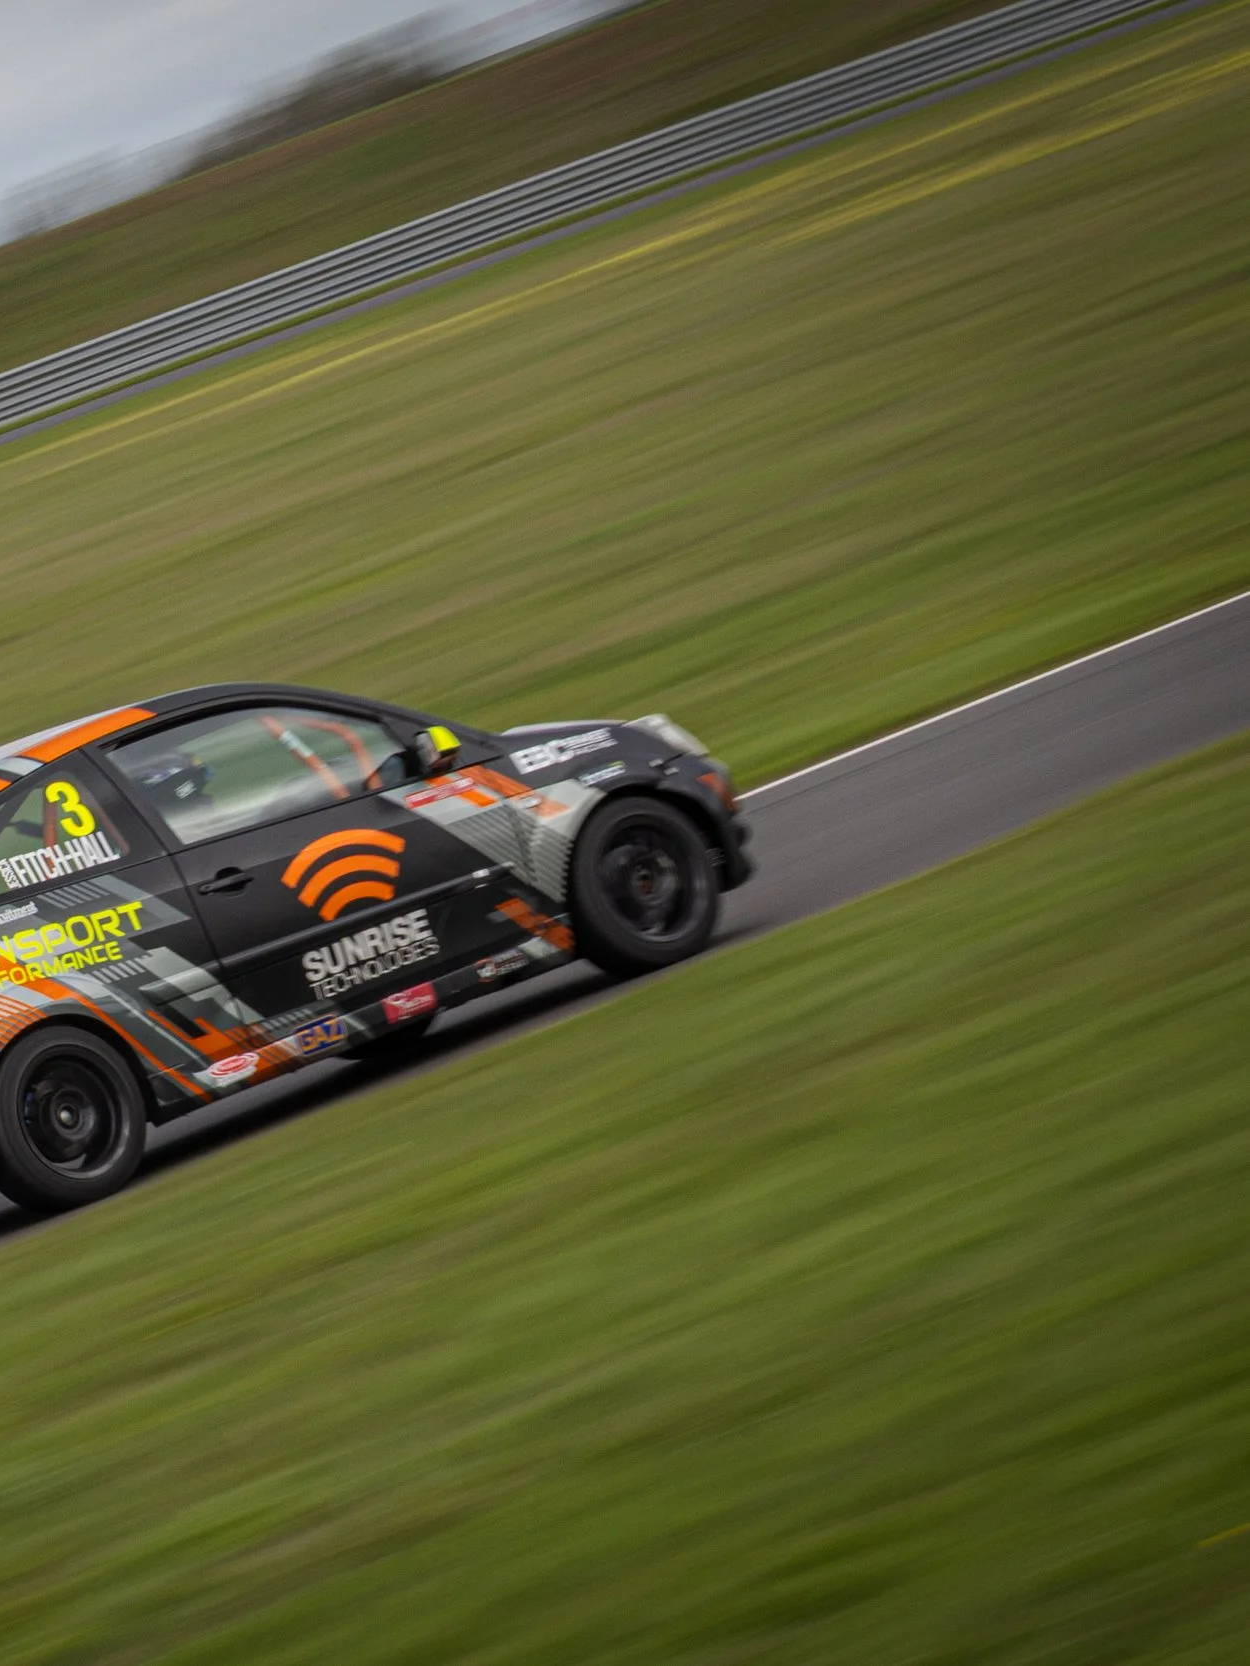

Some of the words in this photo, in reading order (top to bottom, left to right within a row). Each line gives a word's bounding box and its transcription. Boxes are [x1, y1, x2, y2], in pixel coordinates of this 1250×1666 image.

[45, 781, 96, 837] 3
[9, 831, 121, 887] FITCH-HALL
[301, 908, 433, 982] SUNRISE
